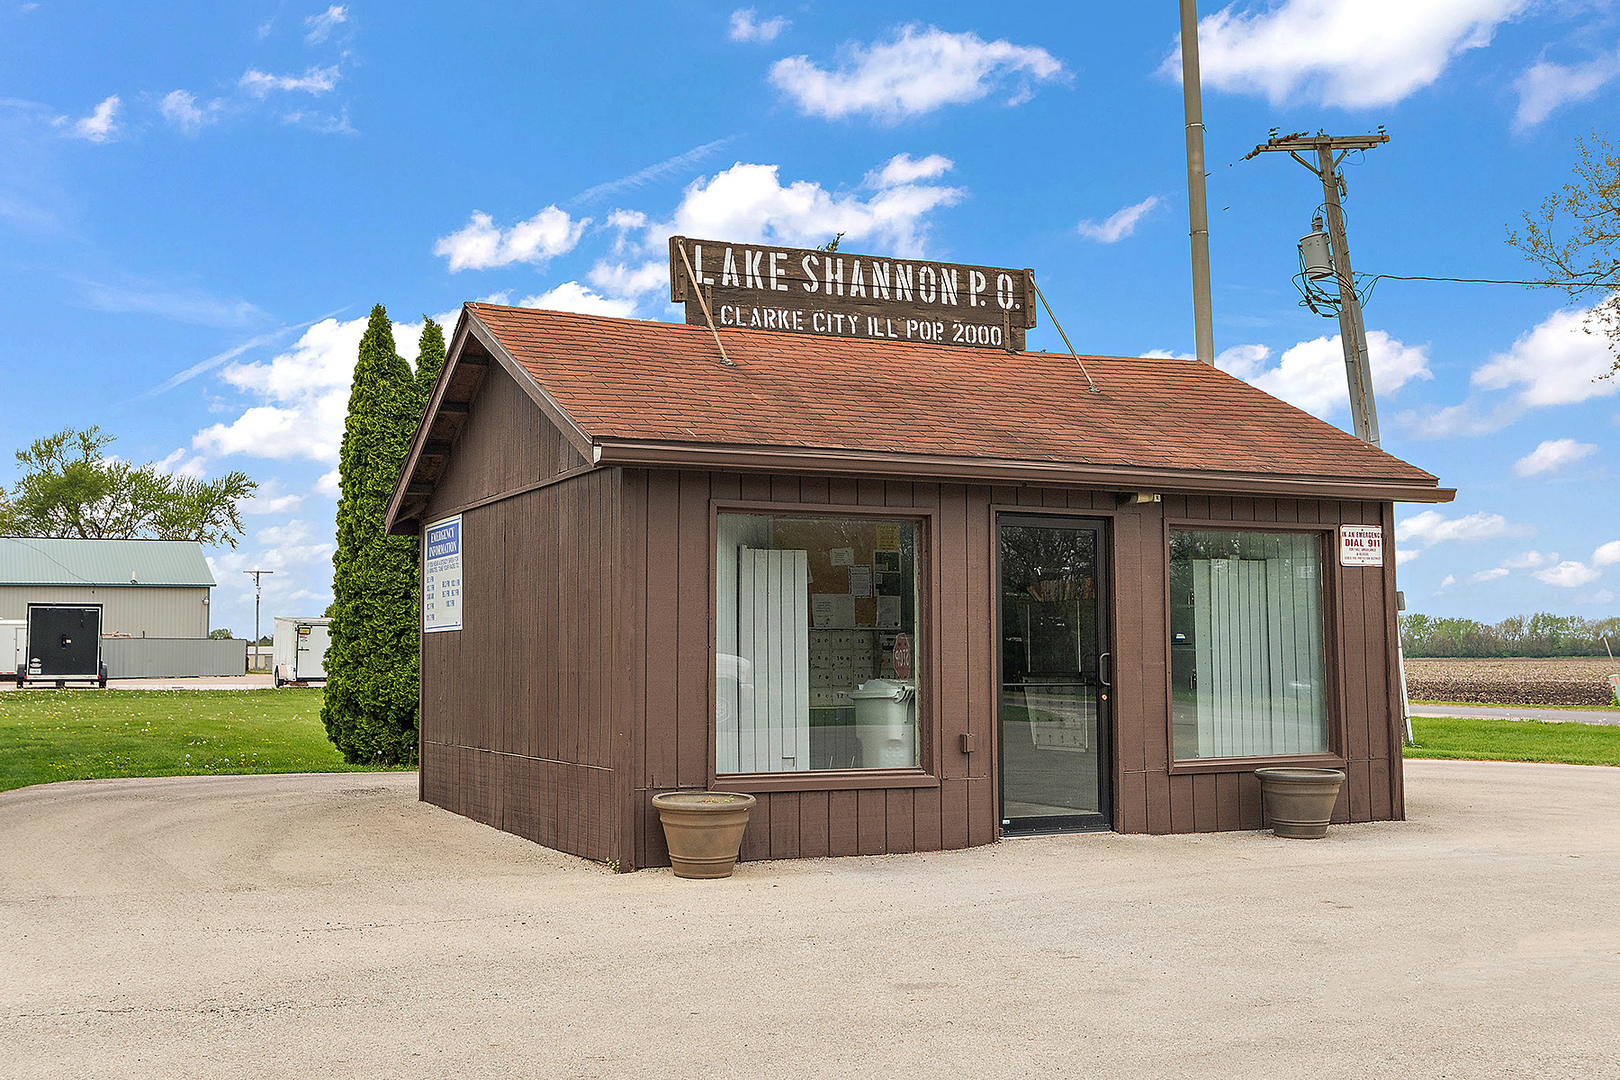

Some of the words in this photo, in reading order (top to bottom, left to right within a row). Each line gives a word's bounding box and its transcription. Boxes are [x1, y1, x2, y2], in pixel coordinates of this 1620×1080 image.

[694, 244, 789, 291] LAKE
[801, 254, 958, 306] SHANNON
[720, 304, 804, 331] CLARKE
[812, 312, 859, 335] CITY
[868, 315, 898, 339] ILL
[952, 323, 1002, 346] 2000
[1345, 538, 1364, 547] DIAL
[1367, 538, 1380, 548] 911
[1356, 531, 1383, 539] EMERGENCY
